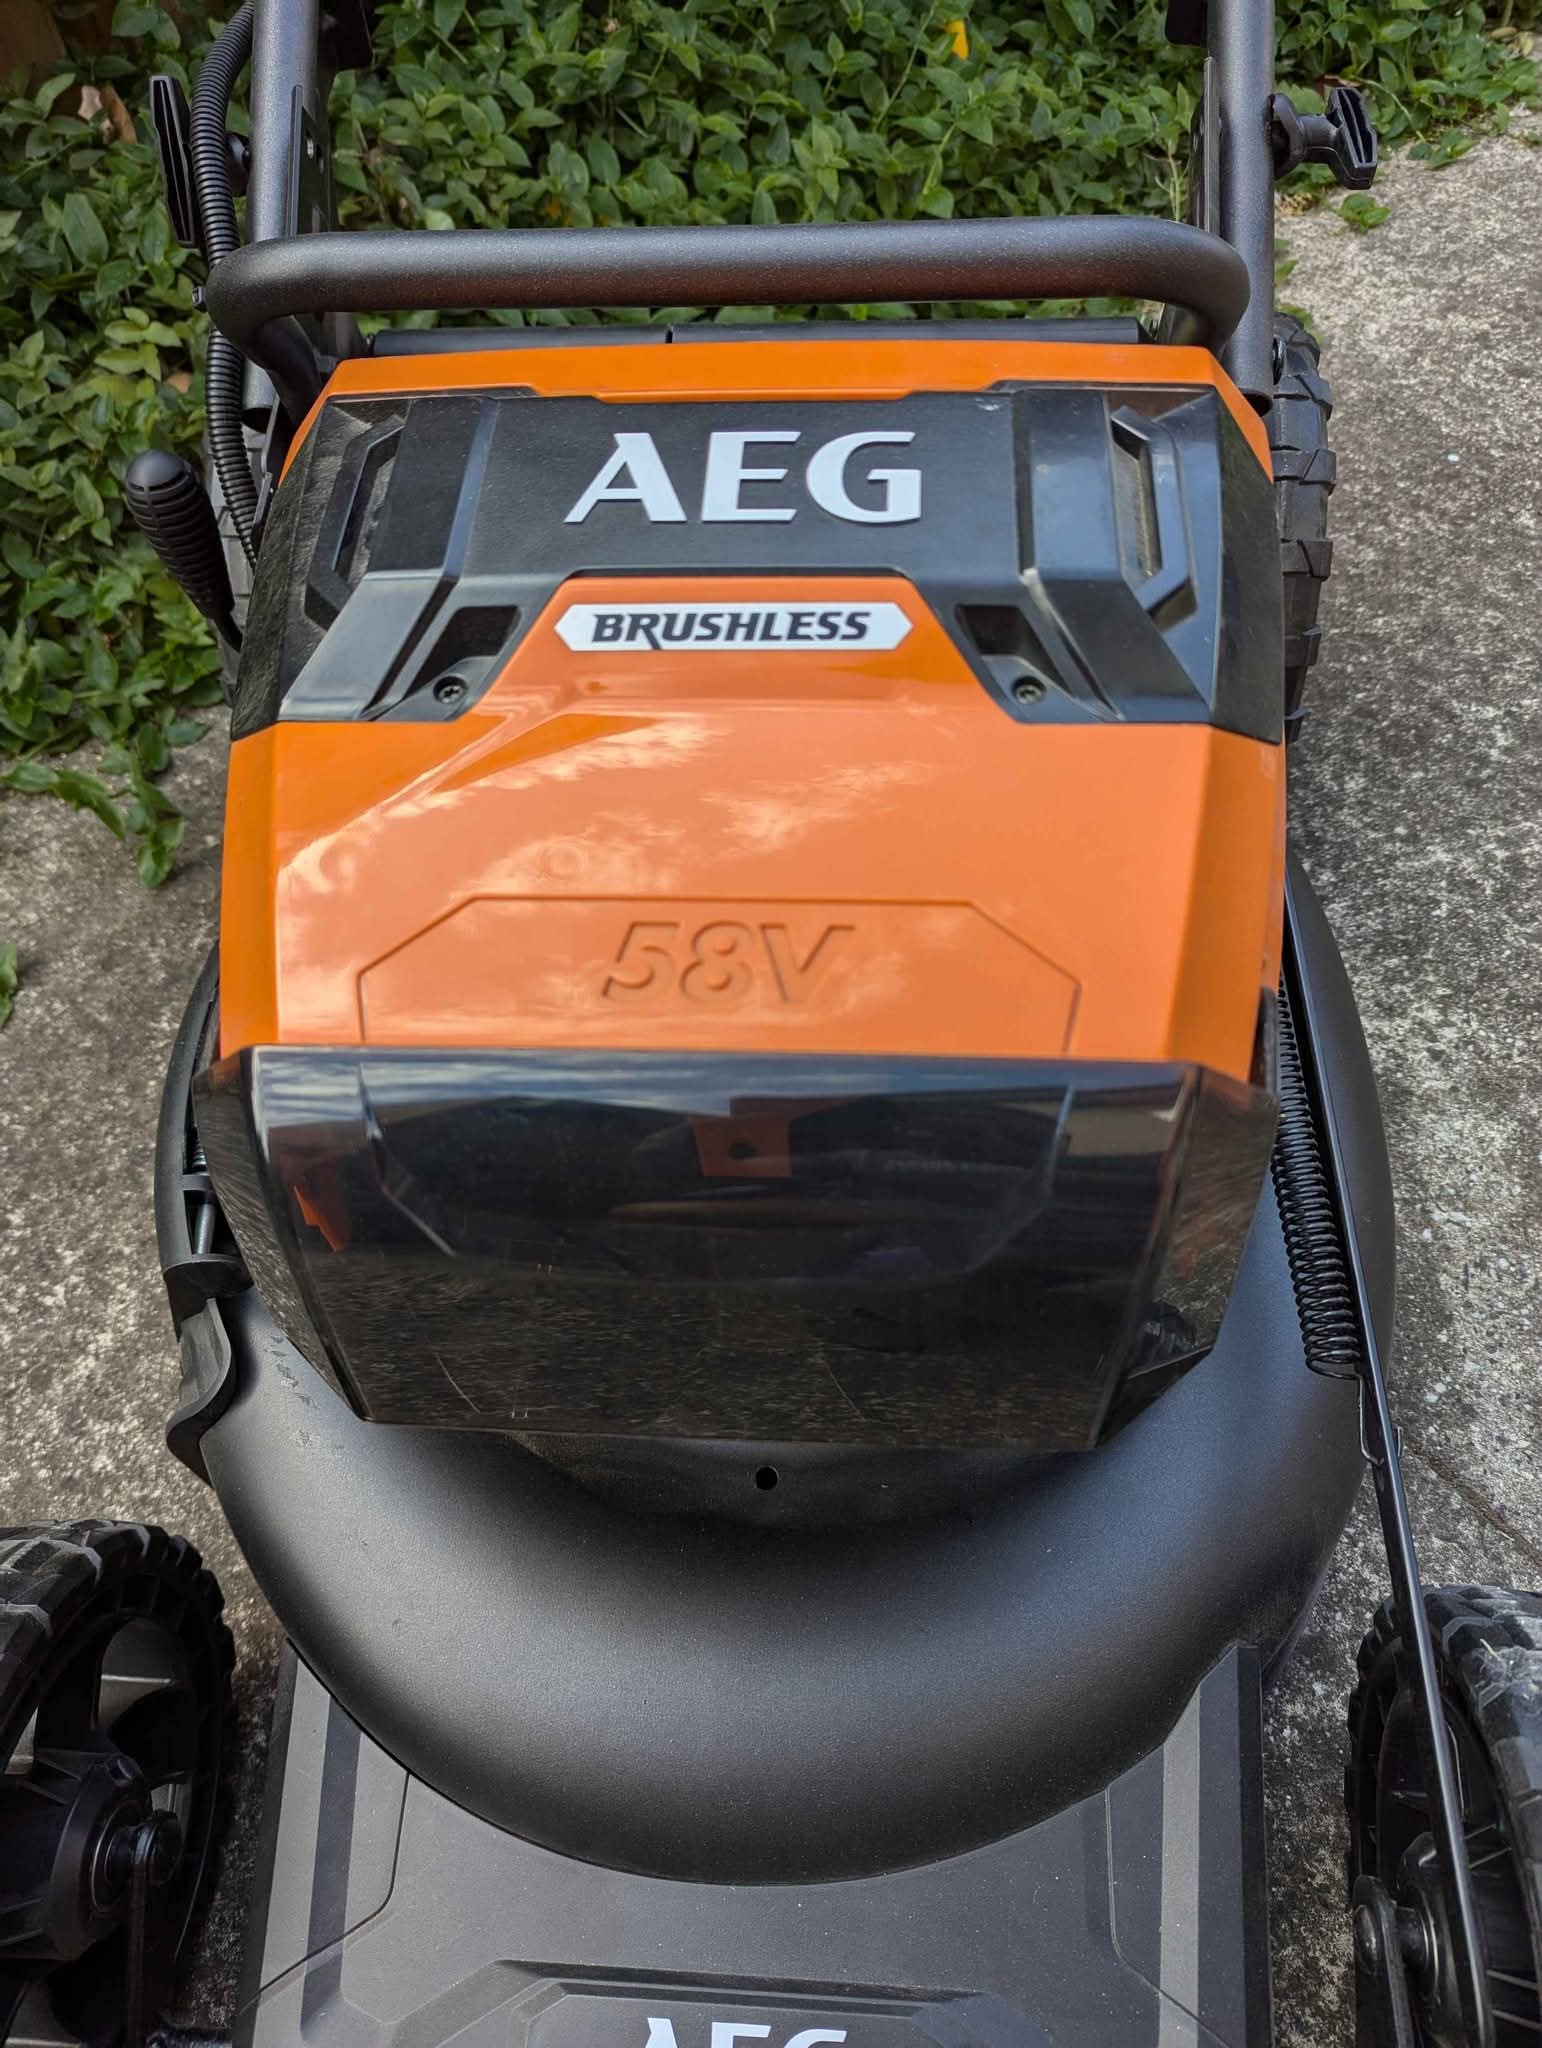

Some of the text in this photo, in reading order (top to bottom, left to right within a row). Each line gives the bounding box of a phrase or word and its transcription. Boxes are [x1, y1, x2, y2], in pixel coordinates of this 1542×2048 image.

[563, 431, 922, 523] AEG
[591, 611, 871, 650] BRUSHLESS
[602, 920, 855, 1003] 58V
